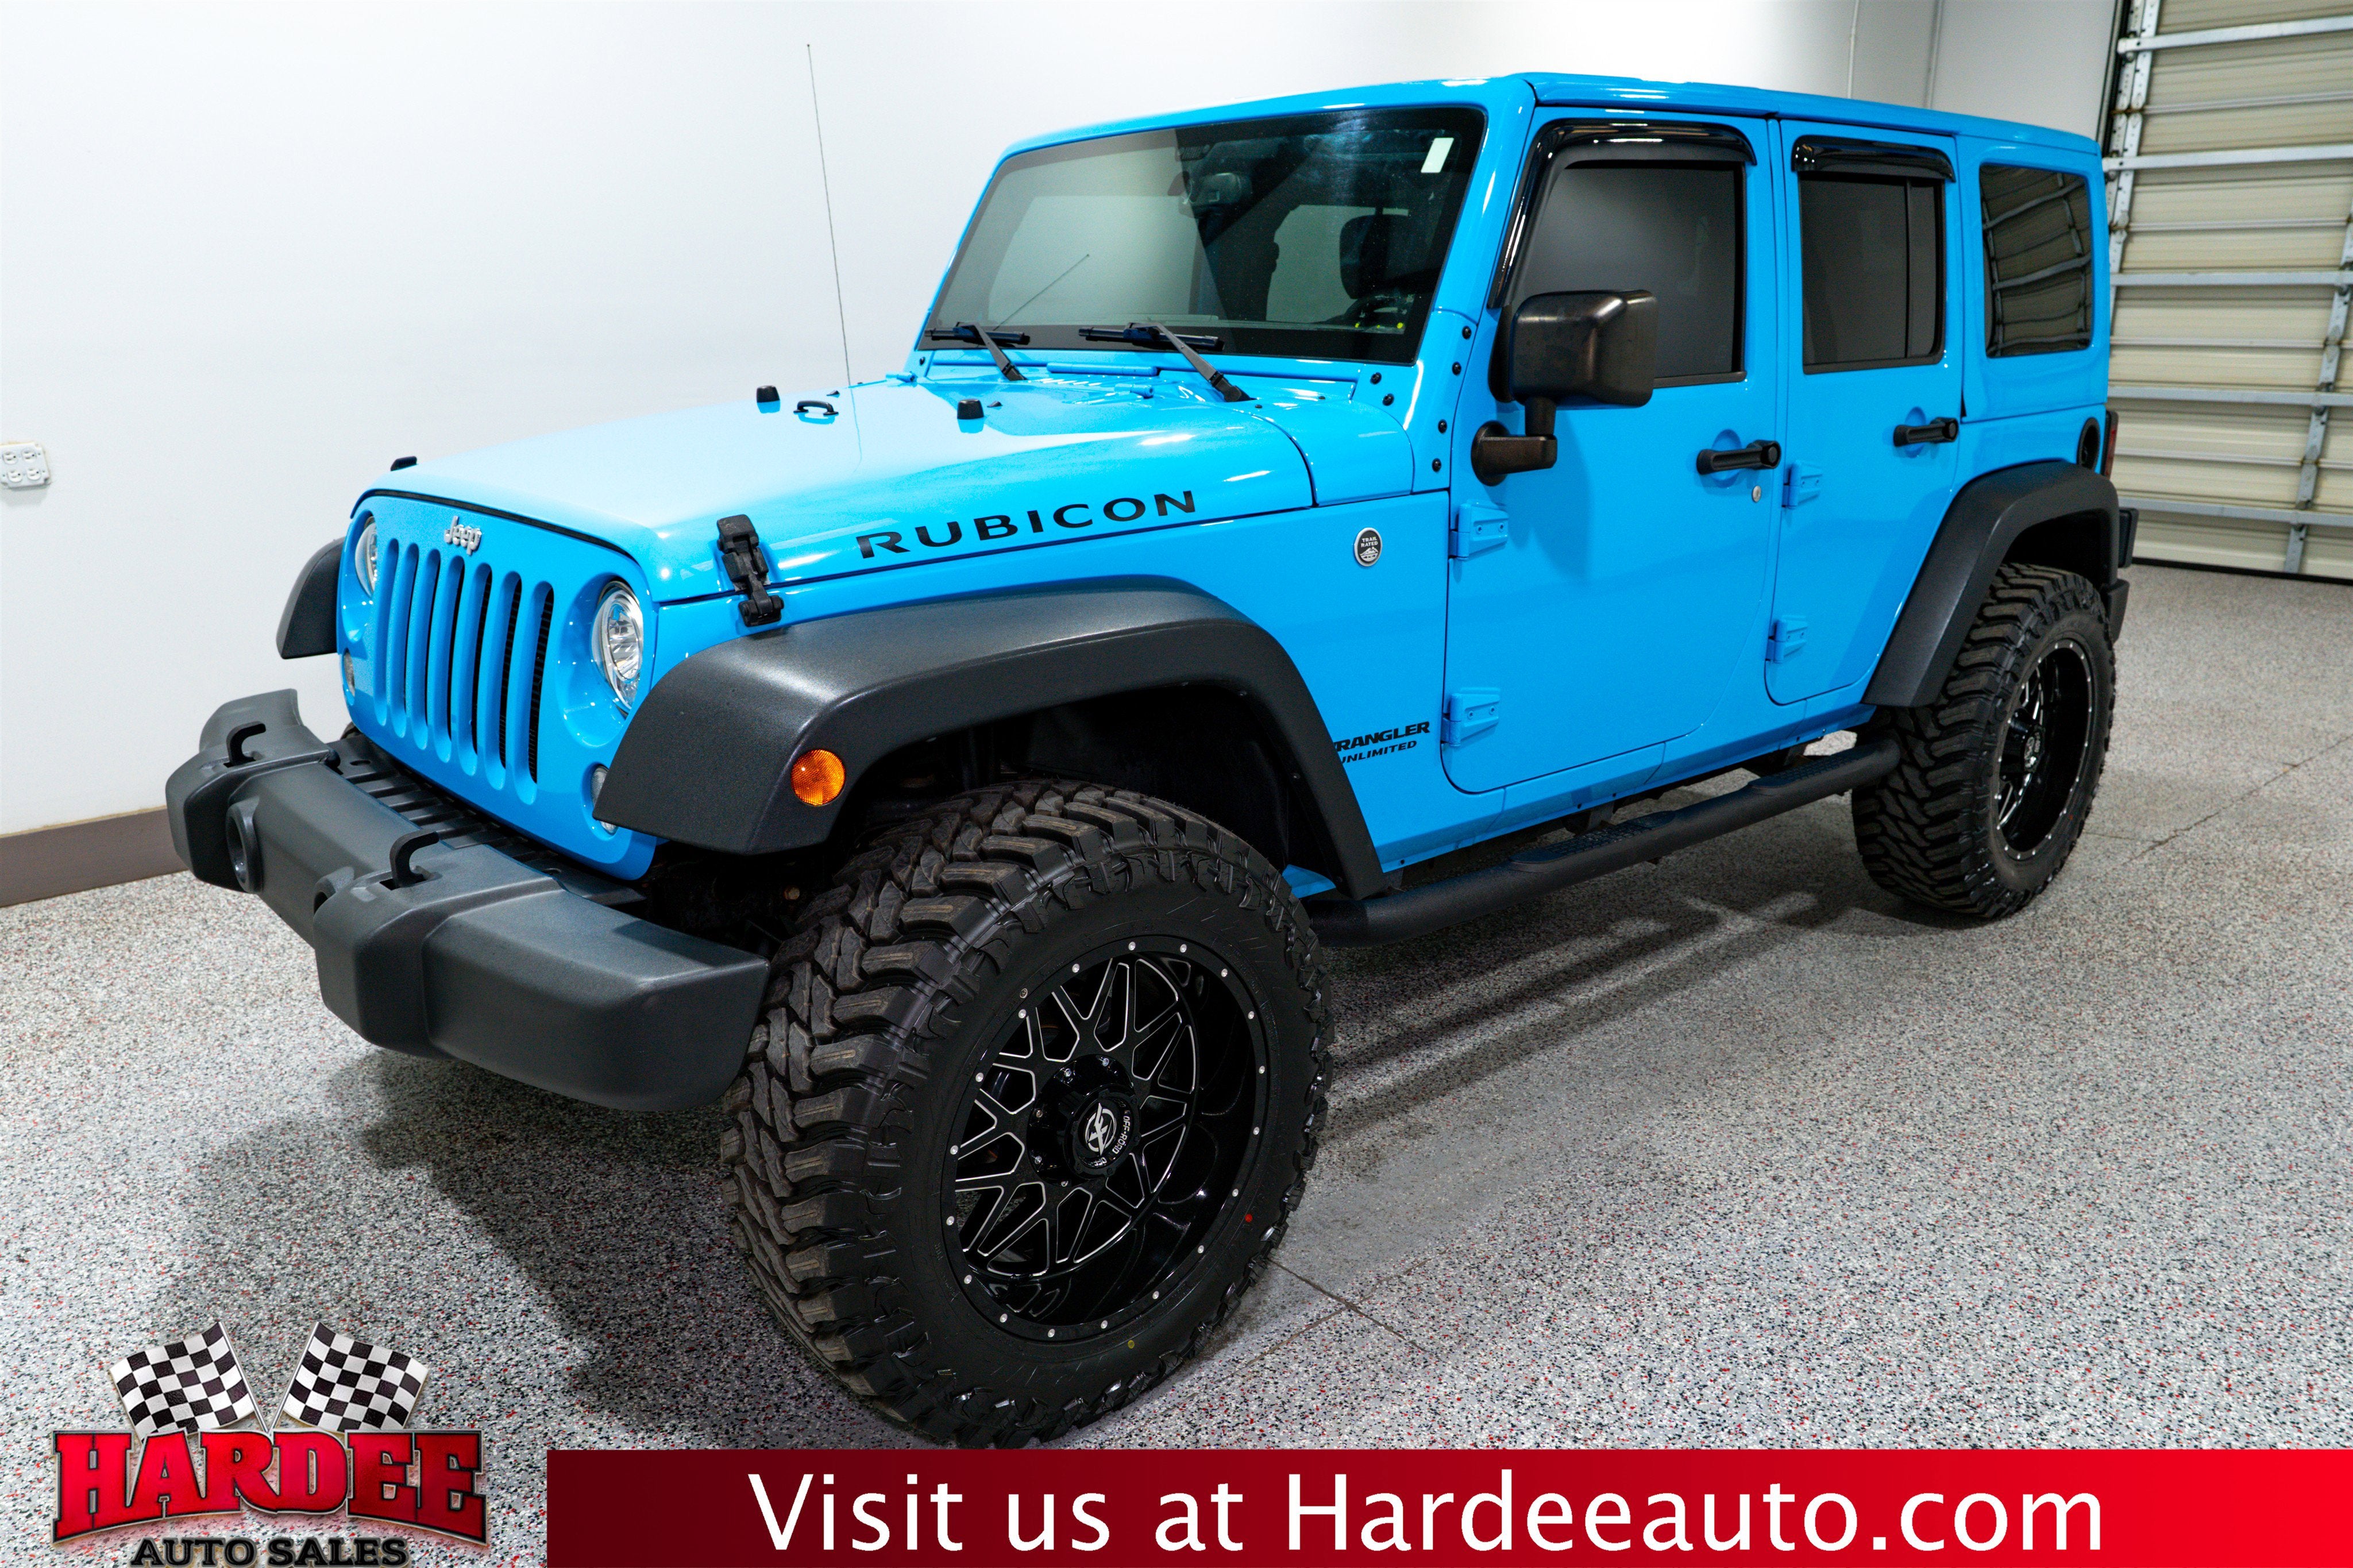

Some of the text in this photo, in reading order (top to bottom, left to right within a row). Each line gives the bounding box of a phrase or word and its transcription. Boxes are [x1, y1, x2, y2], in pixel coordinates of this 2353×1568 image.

[444, 516, 482, 555] Jeep
[856, 490, 1196, 559] RUBICON
[1333, 721, 1430, 752] RANGLER
